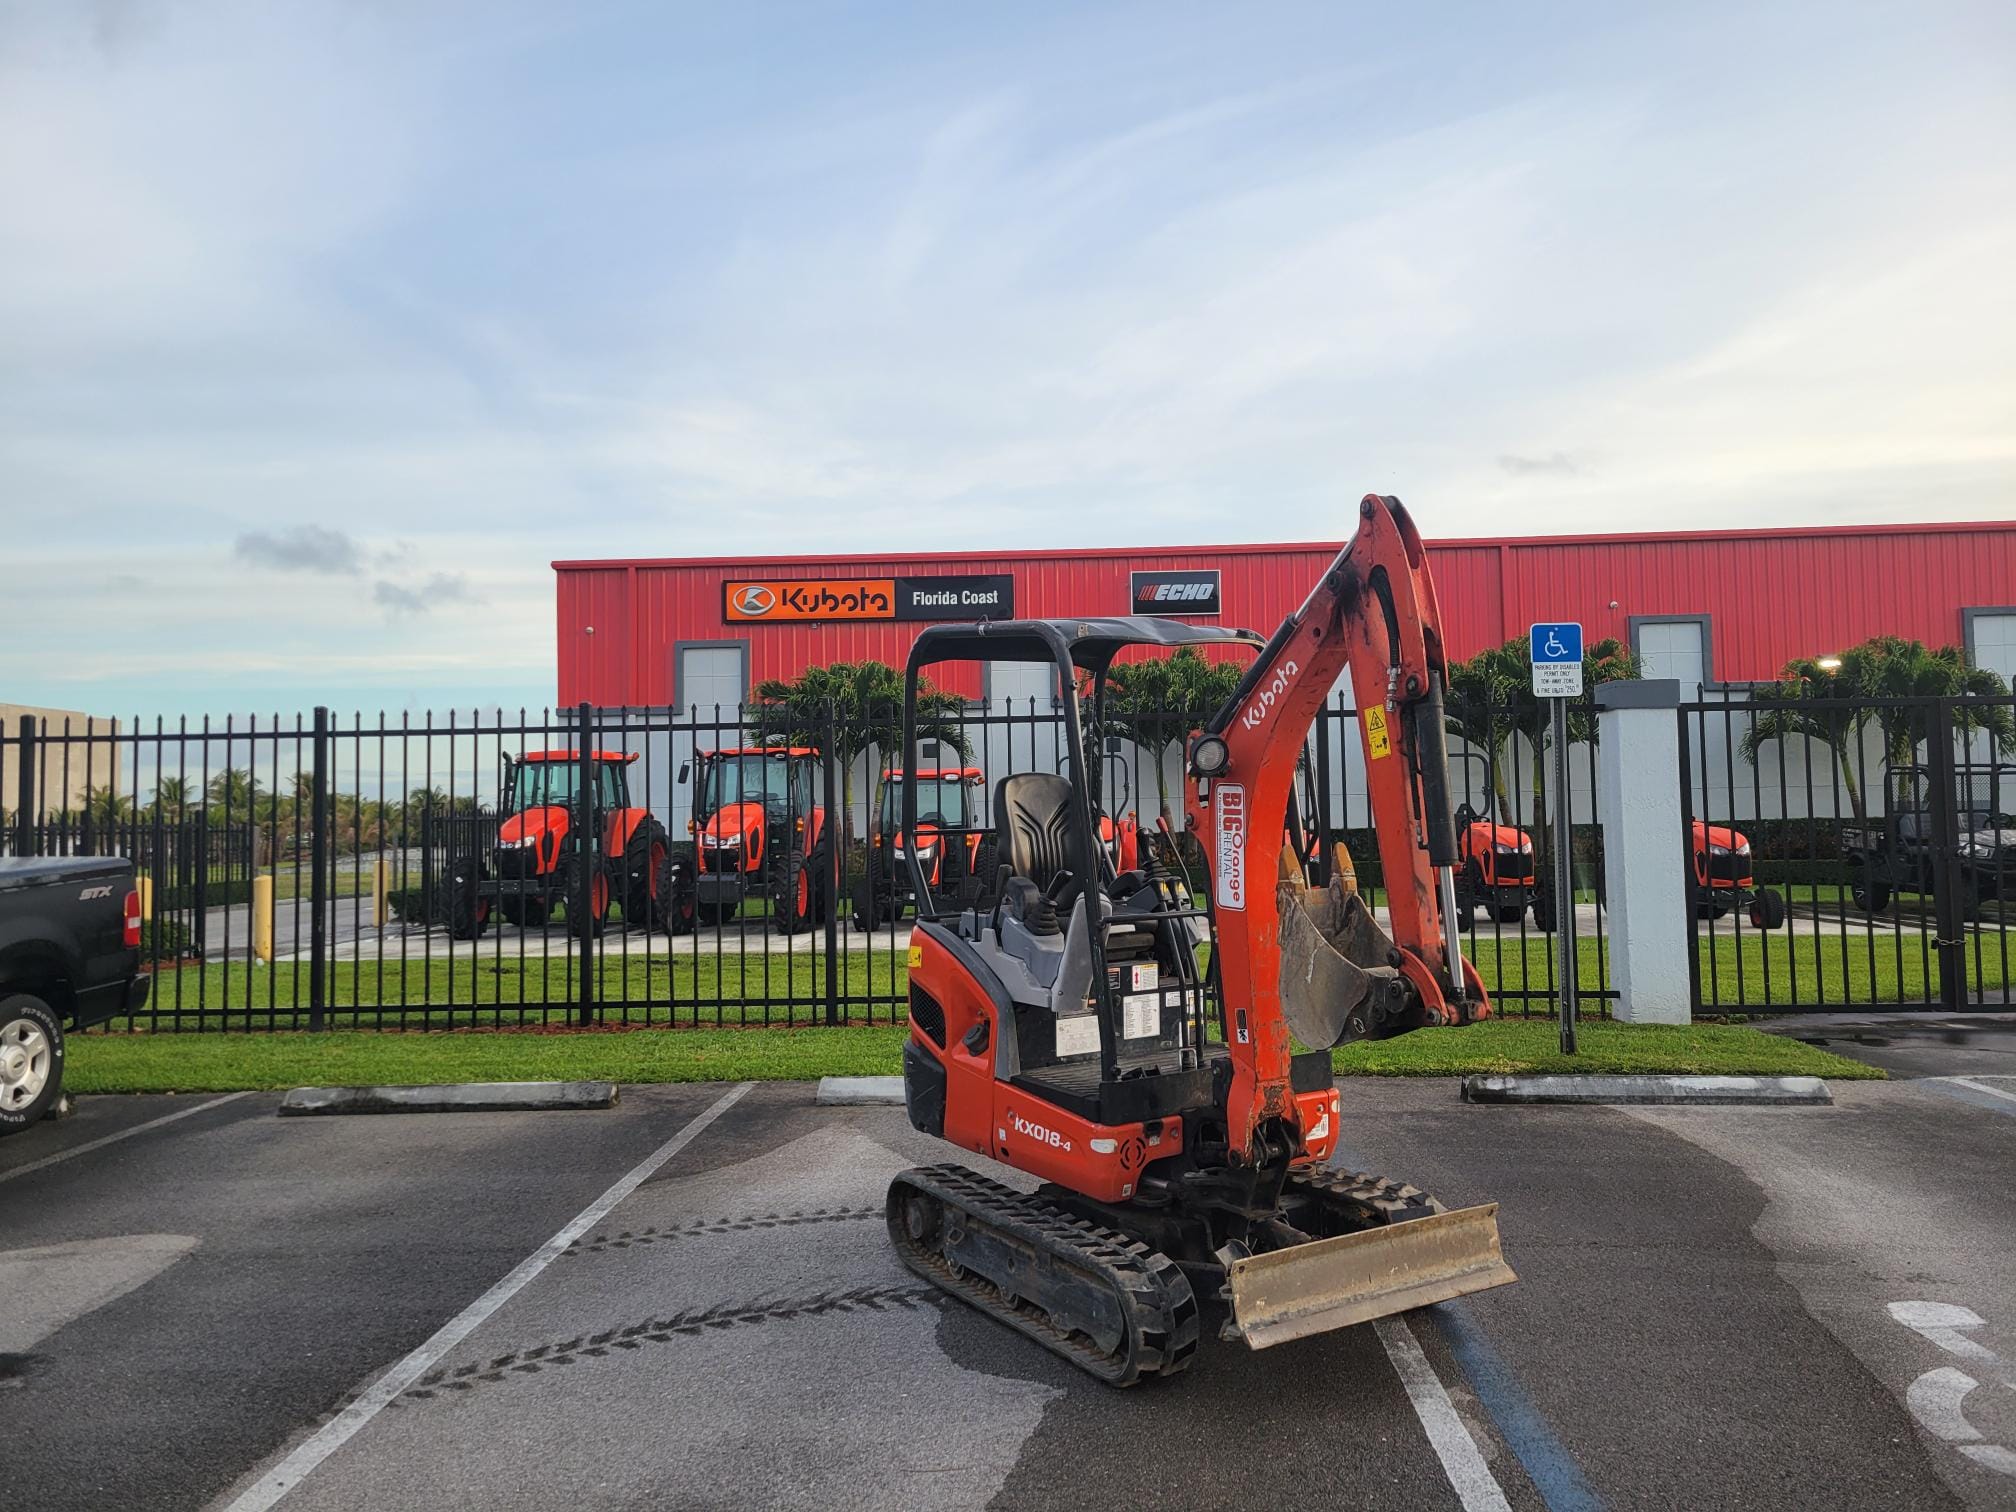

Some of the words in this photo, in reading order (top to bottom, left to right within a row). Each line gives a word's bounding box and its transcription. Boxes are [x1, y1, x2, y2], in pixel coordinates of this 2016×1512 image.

[782, 587, 888, 612] Kubota
[913, 590, 958, 606] Florida
[961, 590, 998, 605] Coast
[1154, 583, 1214, 601] ECHO
[1242, 660, 1299, 731] Kubota
[1222, 792, 1243, 831] BIG
[1223, 832, 1232, 879] RENTAL
[1229, 832, 1244, 902] Orange
[1014, 1116, 1071, 1151] KX018-4
